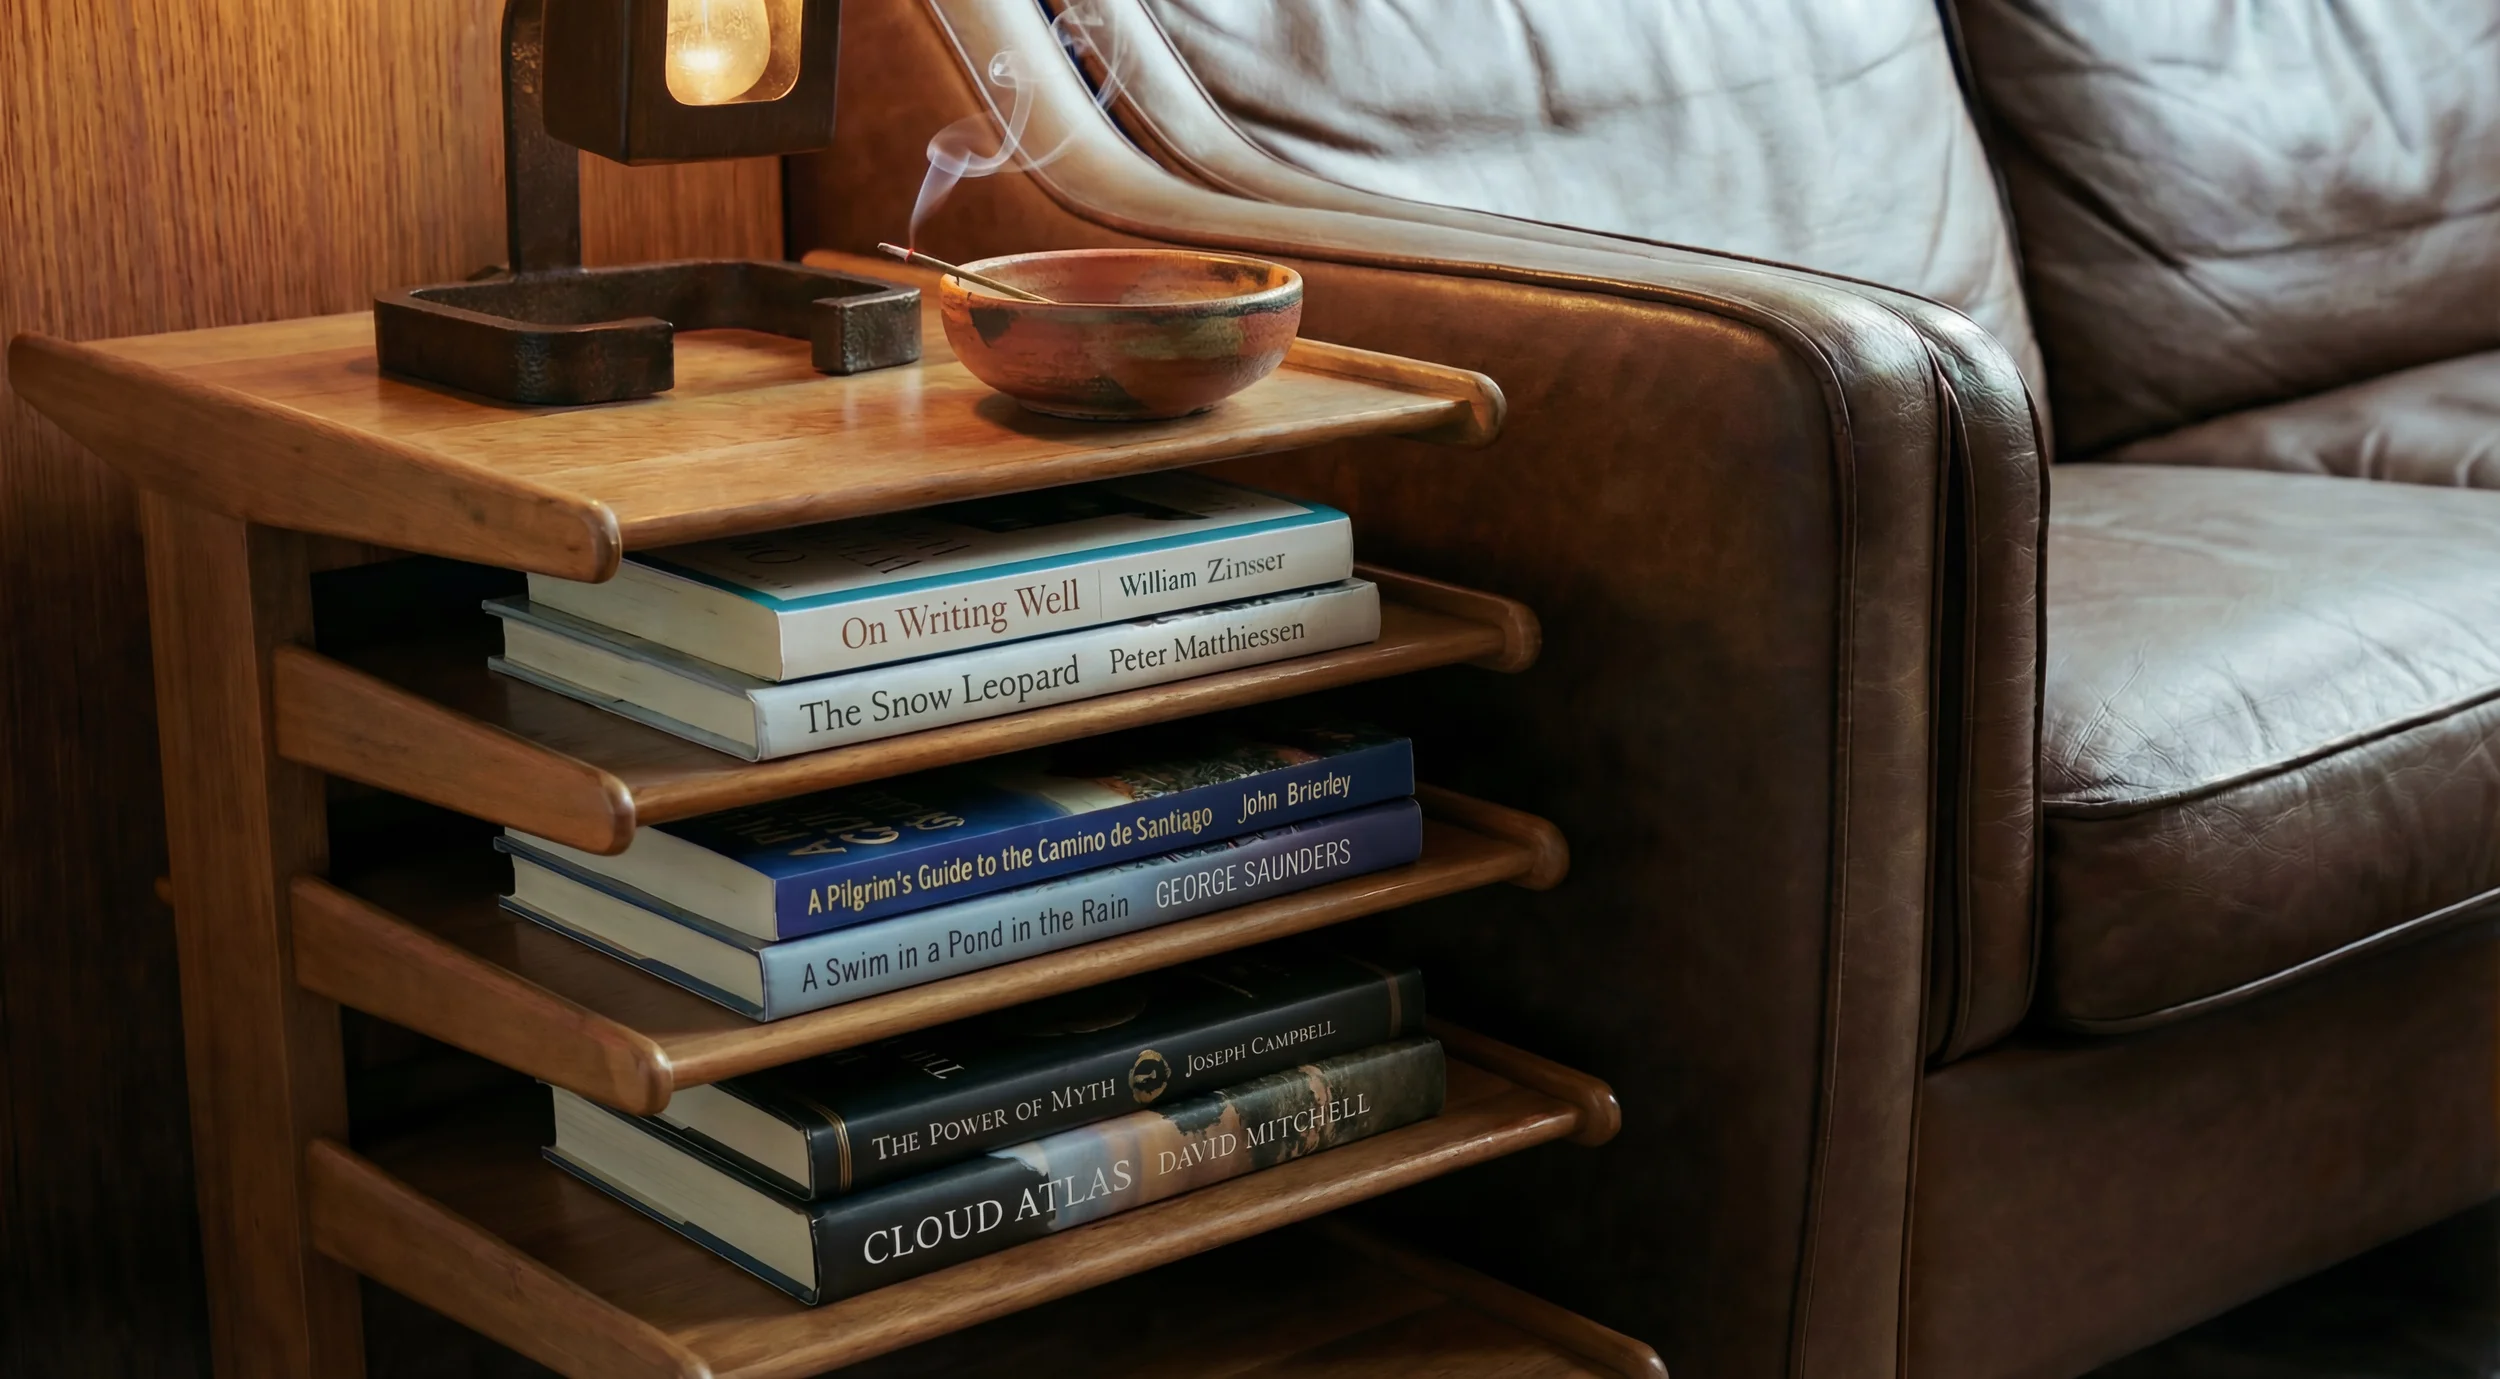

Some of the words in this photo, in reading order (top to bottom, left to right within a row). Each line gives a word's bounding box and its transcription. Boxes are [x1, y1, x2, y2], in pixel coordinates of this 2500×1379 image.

[842, 617, 888, 649] On
[895, 597, 1008, 640] Writing
[1014, 578, 1081, 618] Well
[1119, 569, 1197, 598] William
[1207, 552, 1286, 584] Zinsser
[799, 699, 862, 734] The
[871, 688, 952, 722] Snow
[962, 653, 1080, 703] Leopard
[1109, 647, 1168, 674] Peter
[1174, 622, 1305, 662] Matthiessen
[802, 962, 818, 993] A
[826, 951, 889, 987] Swim
[899, 943, 918, 970] in
[928, 942, 940, 963] a
[949, 920, 1003, 958] Pond
[1012, 917, 1031, 943] in
[1039, 907, 1073, 936] the
[1082, 893, 1129, 926] Rain
[1156, 864, 1237, 908] GEORGE
[1244, 838, 1351, 887] SAUNDERS
[808, 888, 822, 916] A
[827, 870, 912, 912] Pilgrim's
[918, 857, 973, 890] Guide
[977, 854, 997, 878] to
[1002, 845, 1033, 872] the
[1038, 831, 1106, 863] Camino
[1110, 822, 1132, 847] de
[1137, 807, 1213, 841] Santiago
[1237, 790, 1277, 824] John
[1287, 771, 1351, 806] Brierley
[863, 1199, 1004, 1265] CLOUD
[1014, 1159, 1133, 1222] ATLAS
[1158, 1133, 1237, 1176] DAVID
[1246, 1093, 1371, 1149] MITCHELL
